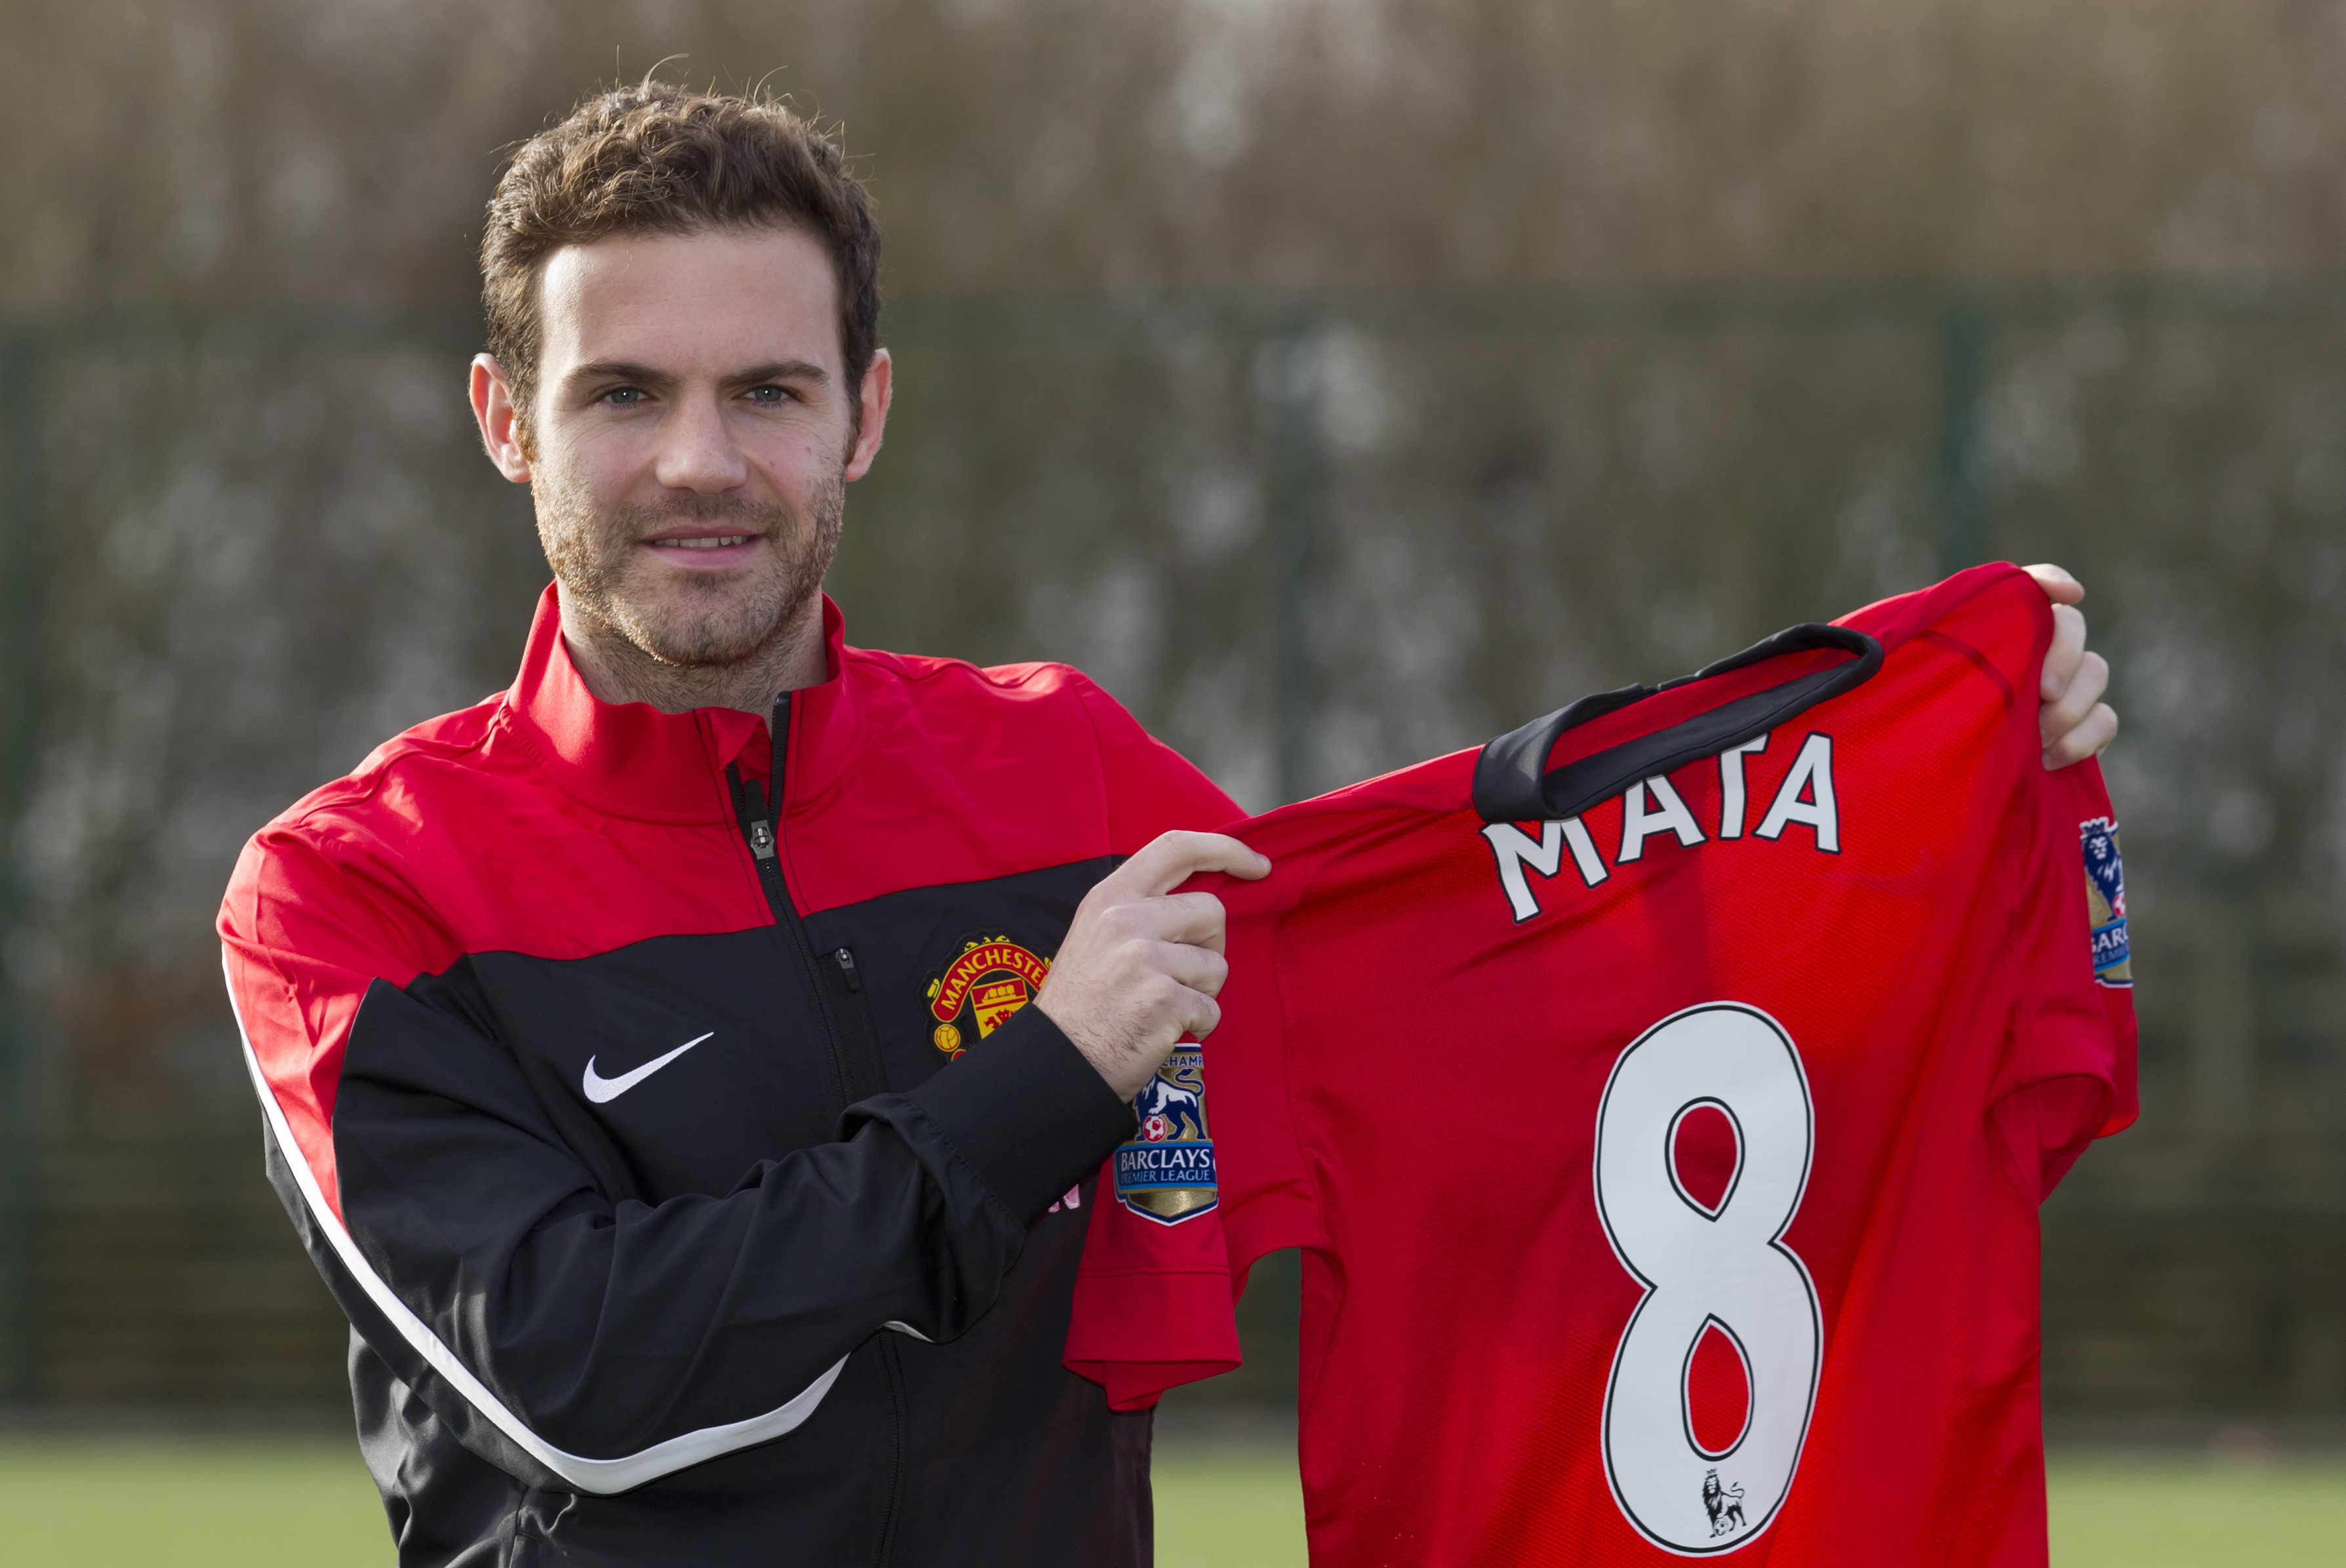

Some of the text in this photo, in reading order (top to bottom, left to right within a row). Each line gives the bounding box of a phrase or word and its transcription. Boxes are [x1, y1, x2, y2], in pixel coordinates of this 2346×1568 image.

[1479, 730, 1842, 925] MATA
[1120, 1169, 1210, 1185] PREMIER LEAGUE
[1121, 1148, 1210, 1172] BARCLAYS
[1593, 1000, 1823, 1558] 8
